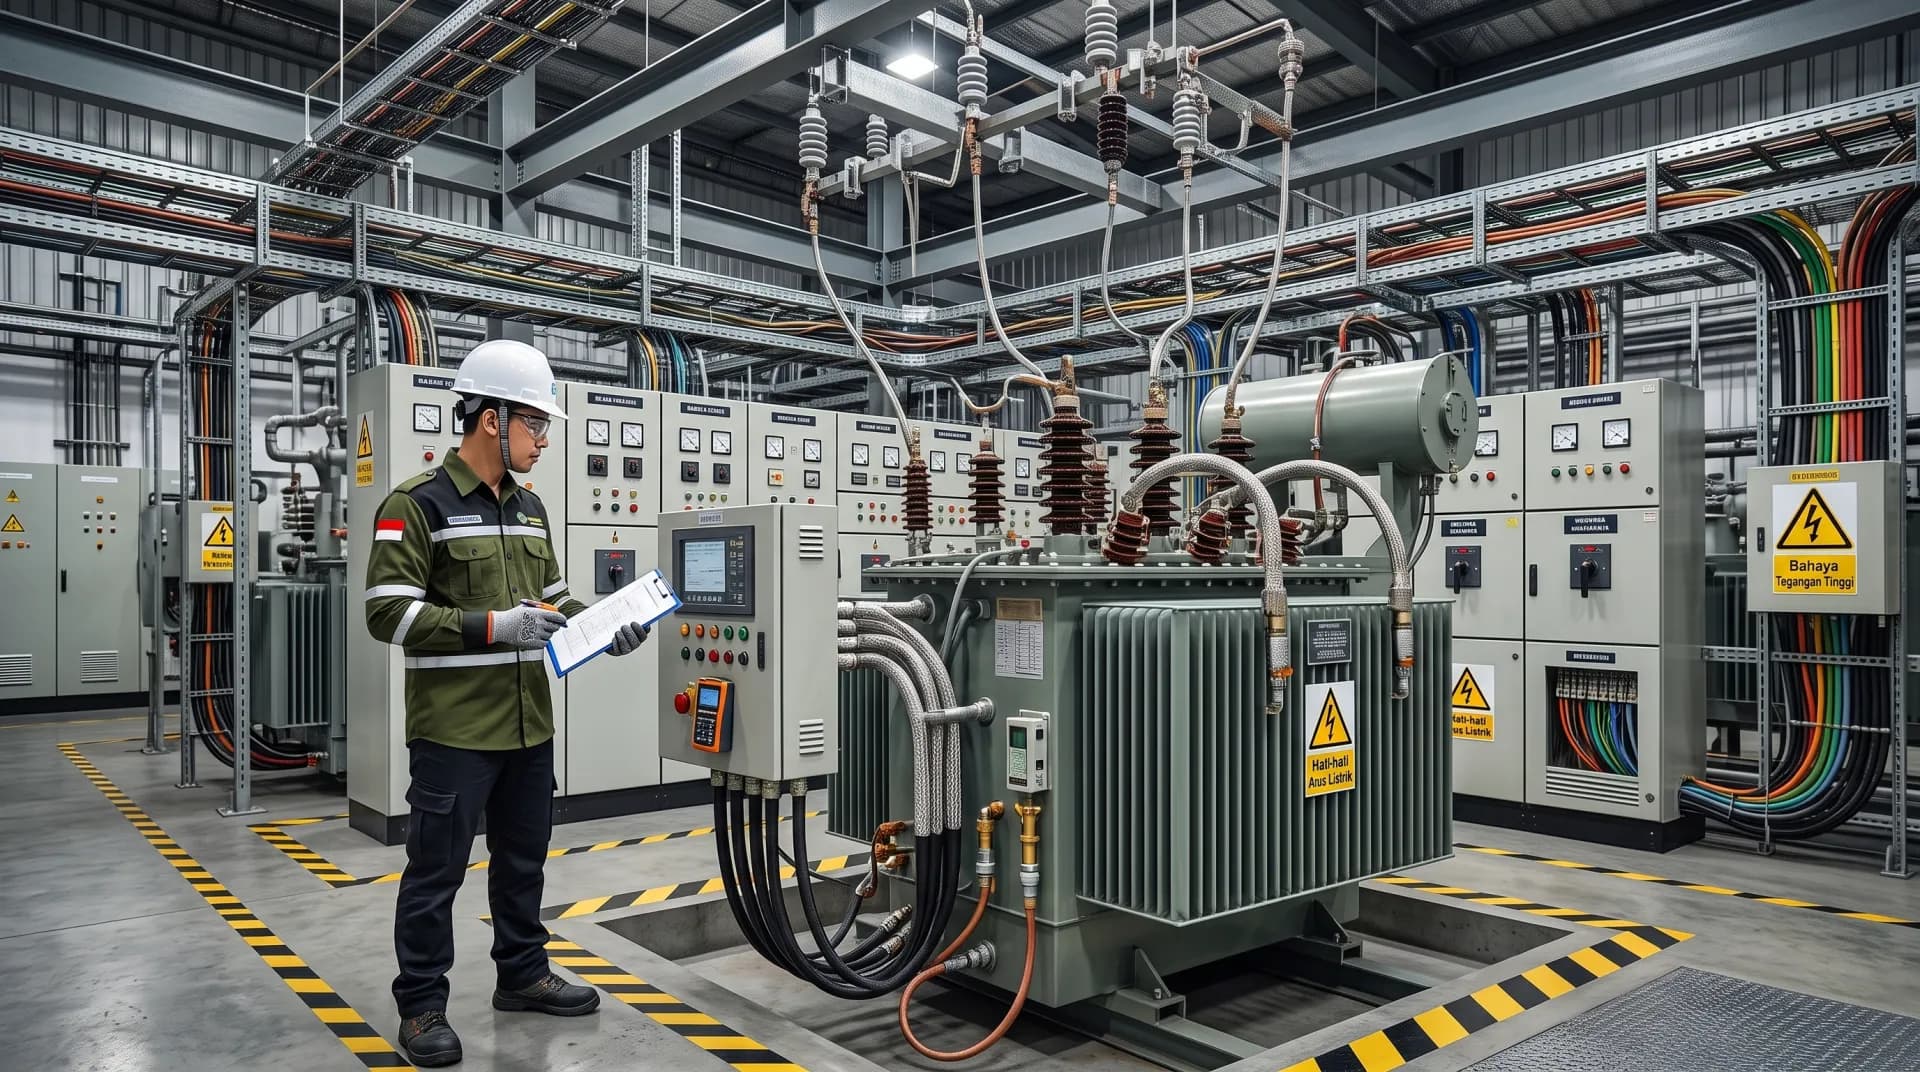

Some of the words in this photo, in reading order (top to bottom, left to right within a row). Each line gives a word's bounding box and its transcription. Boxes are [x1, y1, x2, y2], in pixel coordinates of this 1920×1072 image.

[1789, 560, 1839, 574] Bahaya
[1775, 576, 1822, 589] Tegangan
[1824, 576, 1854, 590] Tinggi
[1465, 726, 1492, 737] Listrik
[1312, 754, 1349, 771] Hati-hati
[1308, 776, 1327, 788] Arus
[1328, 770, 1353, 785] Listrik
